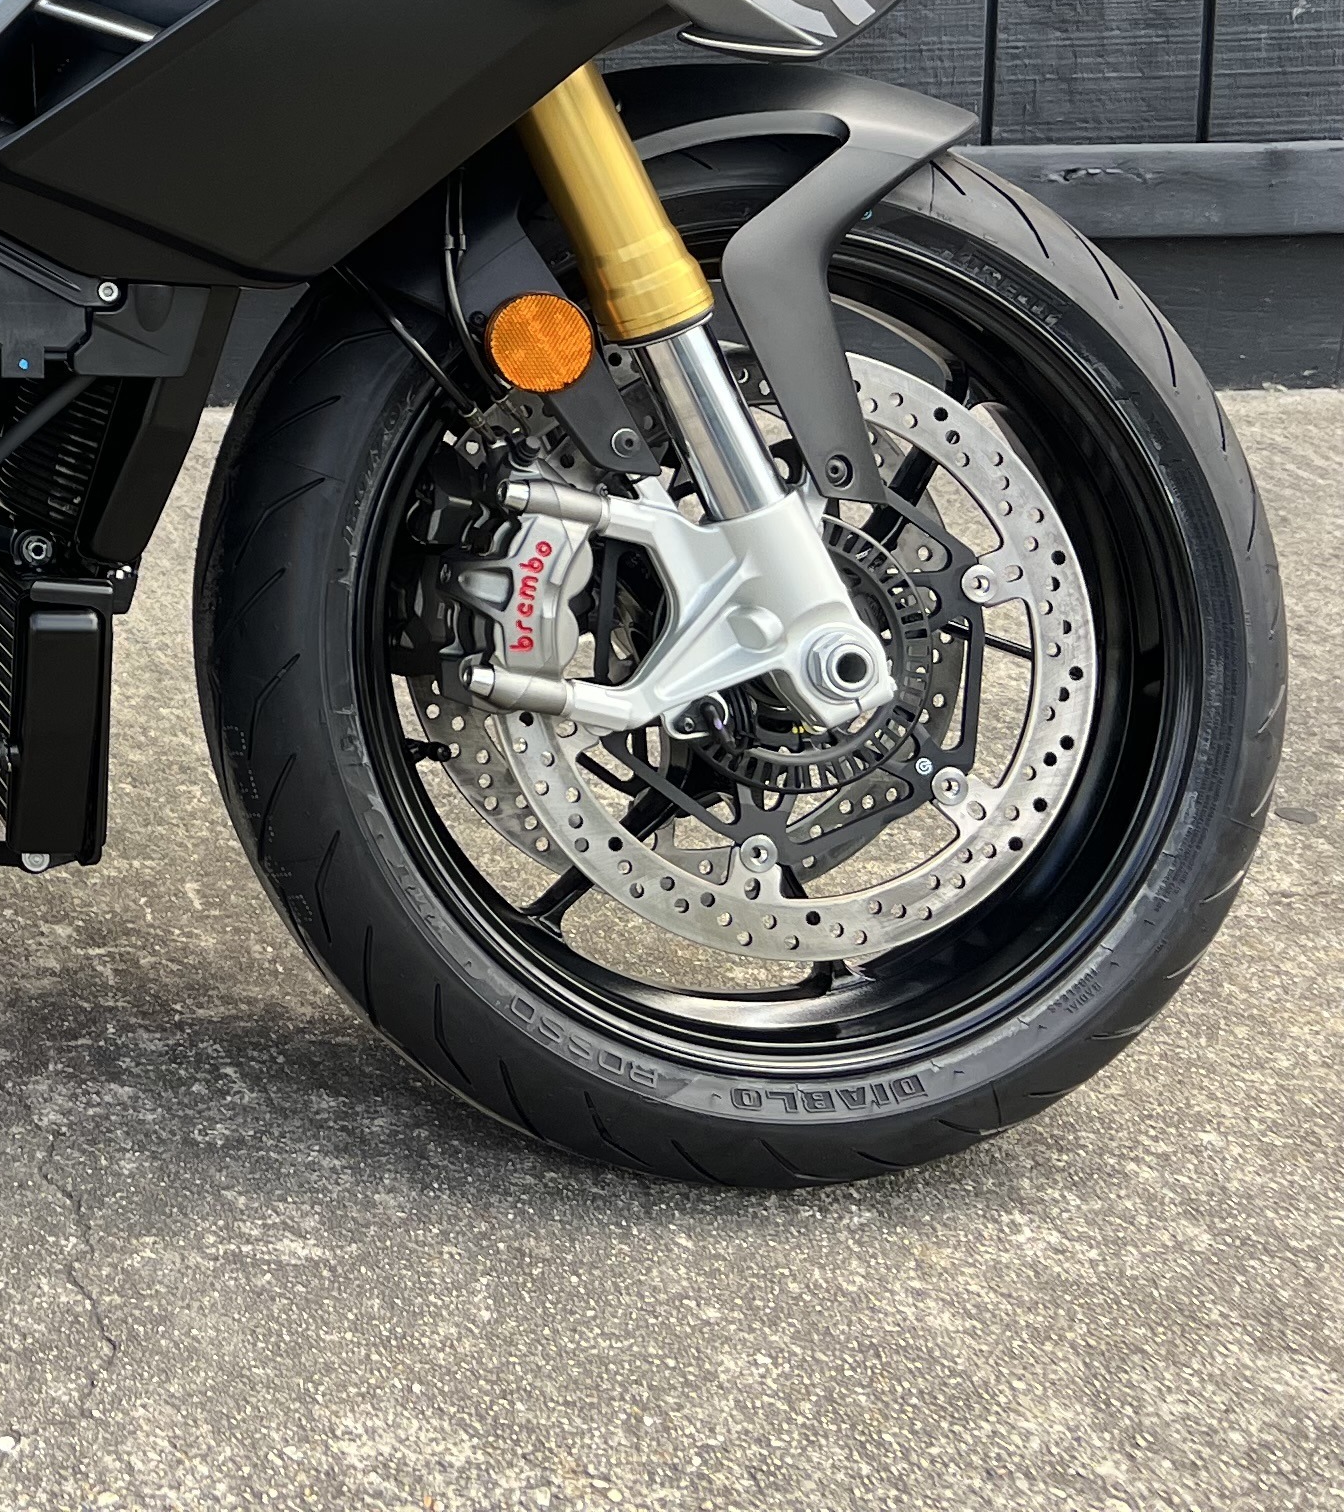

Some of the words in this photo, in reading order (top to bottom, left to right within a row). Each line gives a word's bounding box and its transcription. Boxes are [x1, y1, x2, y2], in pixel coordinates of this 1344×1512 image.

[509, 540, 552, 653] brembo
[510, 994, 660, 1090] ROSSO
[728, 1072, 927, 1115] DIABLO
